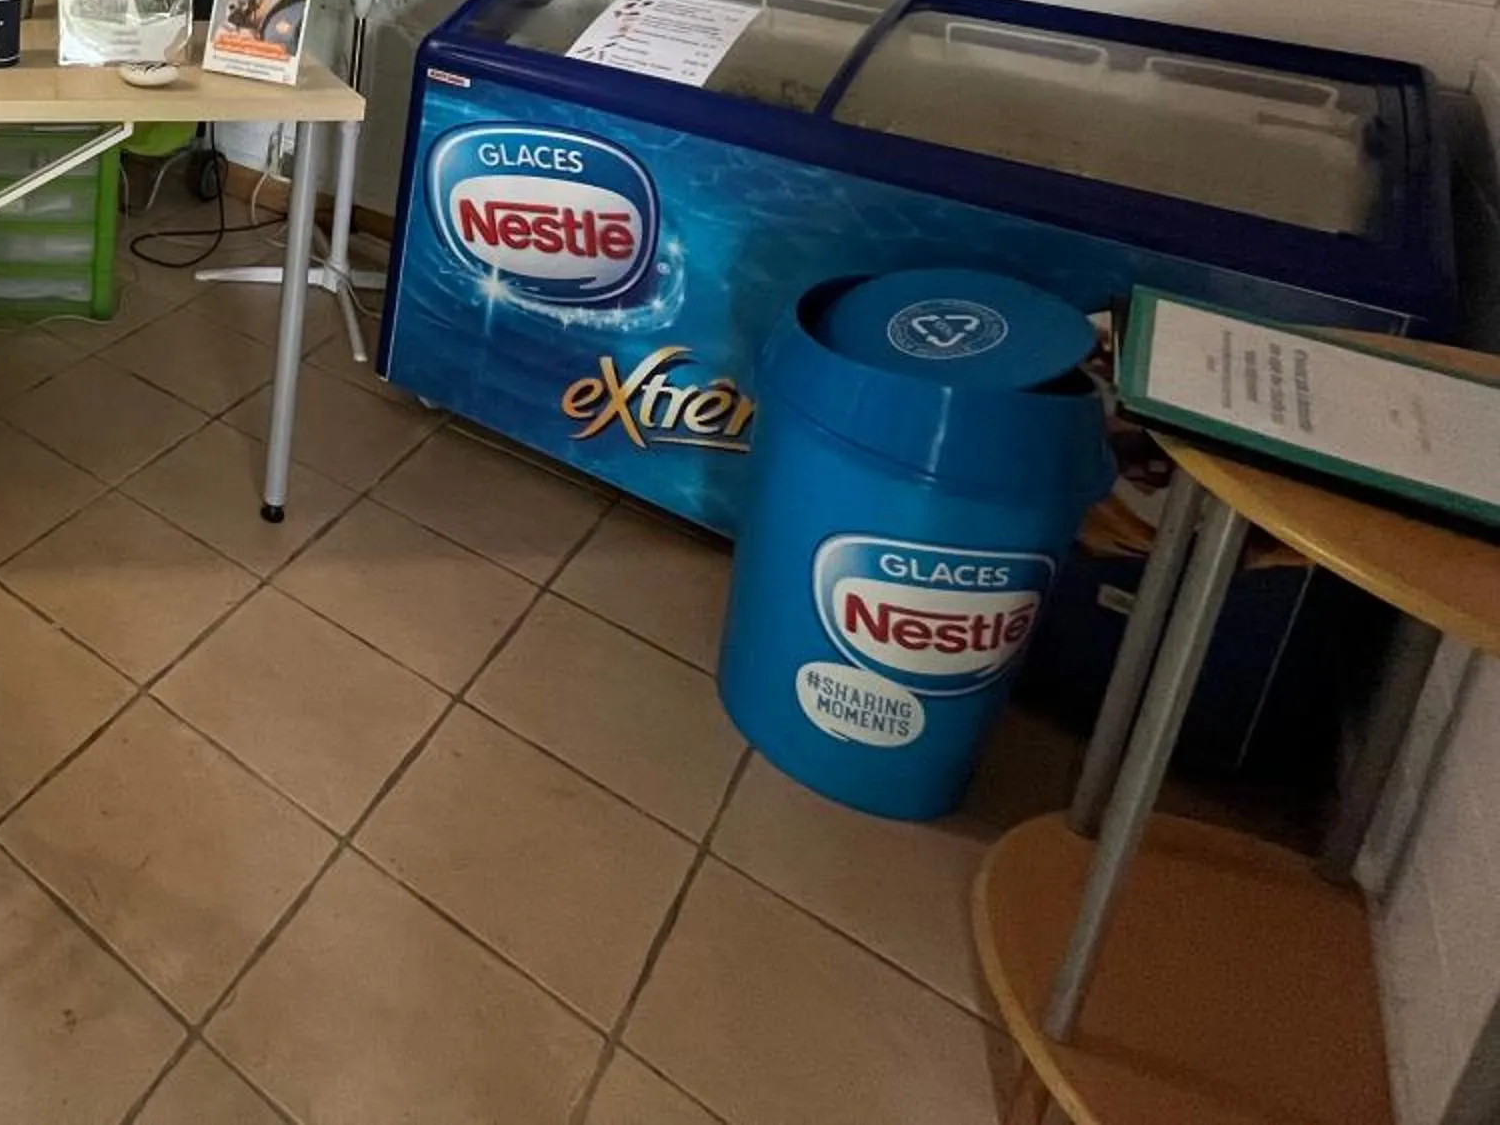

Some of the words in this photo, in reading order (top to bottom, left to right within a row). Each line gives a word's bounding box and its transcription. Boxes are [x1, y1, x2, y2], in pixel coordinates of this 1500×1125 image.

[478, 142, 584, 174] GLACES
[879, 554, 1010, 587] GLACES
[806, 669, 913, 719] #SHARING
[816, 695, 911, 739] MOMENTS
